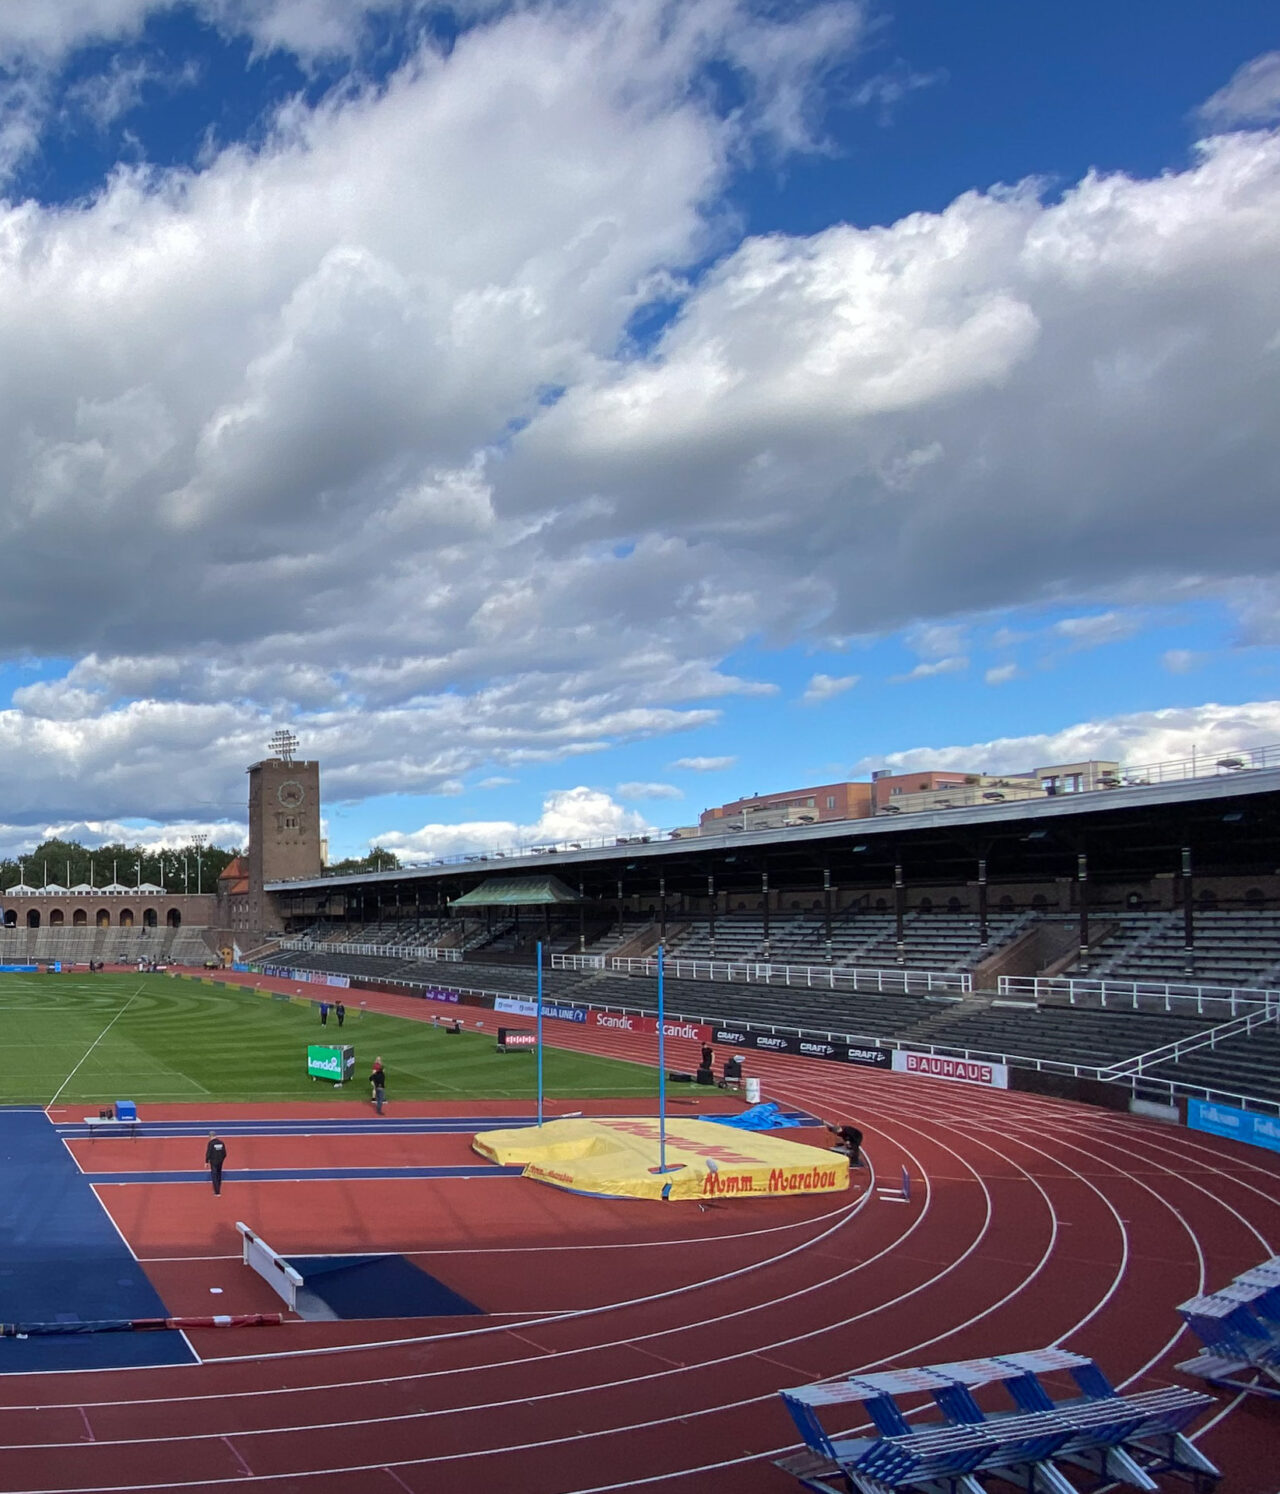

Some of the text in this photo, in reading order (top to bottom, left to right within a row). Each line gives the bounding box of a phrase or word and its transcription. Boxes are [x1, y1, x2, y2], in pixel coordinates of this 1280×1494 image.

[558, 1009, 574, 1019] LINE
[596, 1013, 633, 1030] Scandic
[717, 1031, 738, 1041] CRAFT
[756, 1036, 781, 1047] CRAFT
[800, 1042, 827, 1053] CRAFT
[848, 1048, 878, 1059] CRAFT
[308, 1056, 334, 1071] Lendo
[907, 1056, 991, 1081] BAUHAUS
[769, 1167, 836, 1192] Marabou
